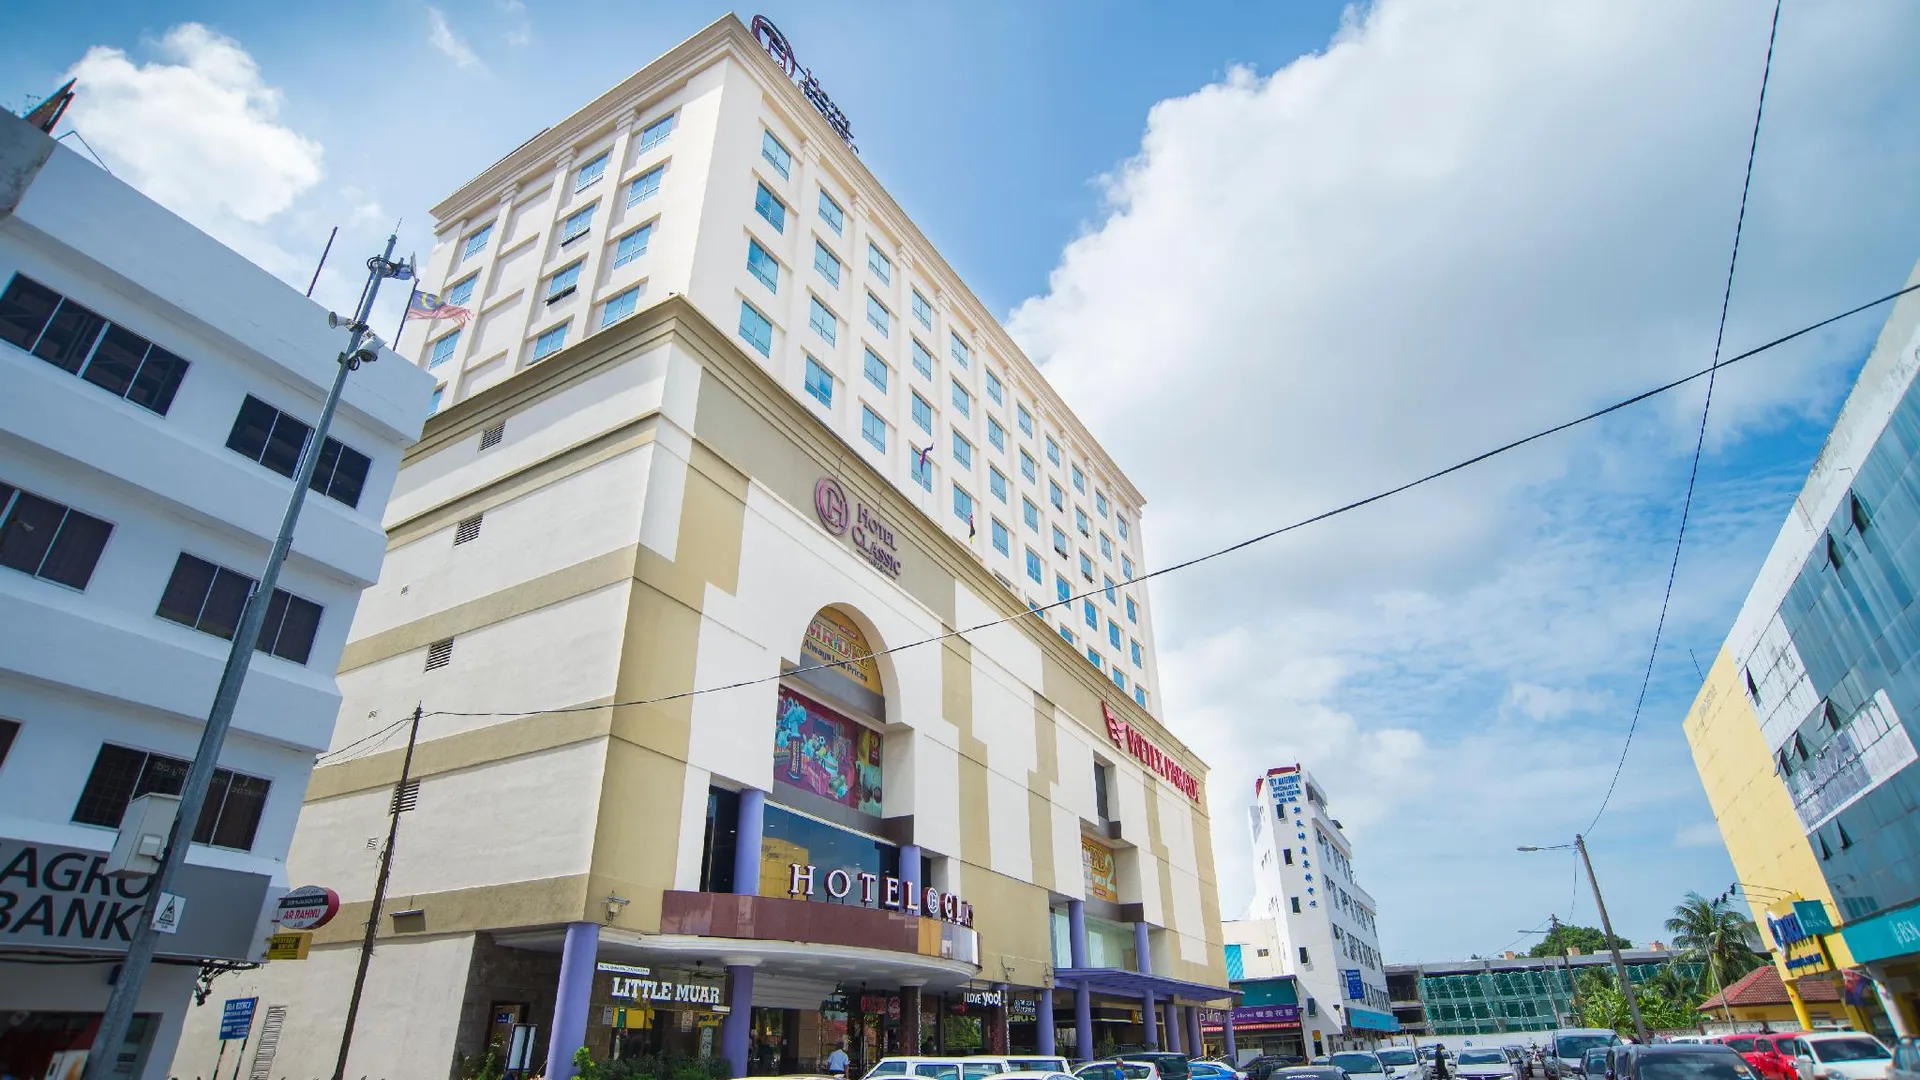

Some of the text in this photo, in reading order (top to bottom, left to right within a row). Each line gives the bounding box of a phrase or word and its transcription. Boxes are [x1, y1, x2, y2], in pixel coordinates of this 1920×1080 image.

[857, 503, 897, 551] HOTEL
[852, 525, 901, 576] CLASSIC
[804, 639, 832, 661] Always
[847, 664, 868, 683] Prices
[789, 863, 919, 911] HOTEL
[283, 908, 321, 920] AR RAHNU
[612, 977, 720, 1004] LITTLE MUAR
[967, 993, 981, 1004] LOVE
